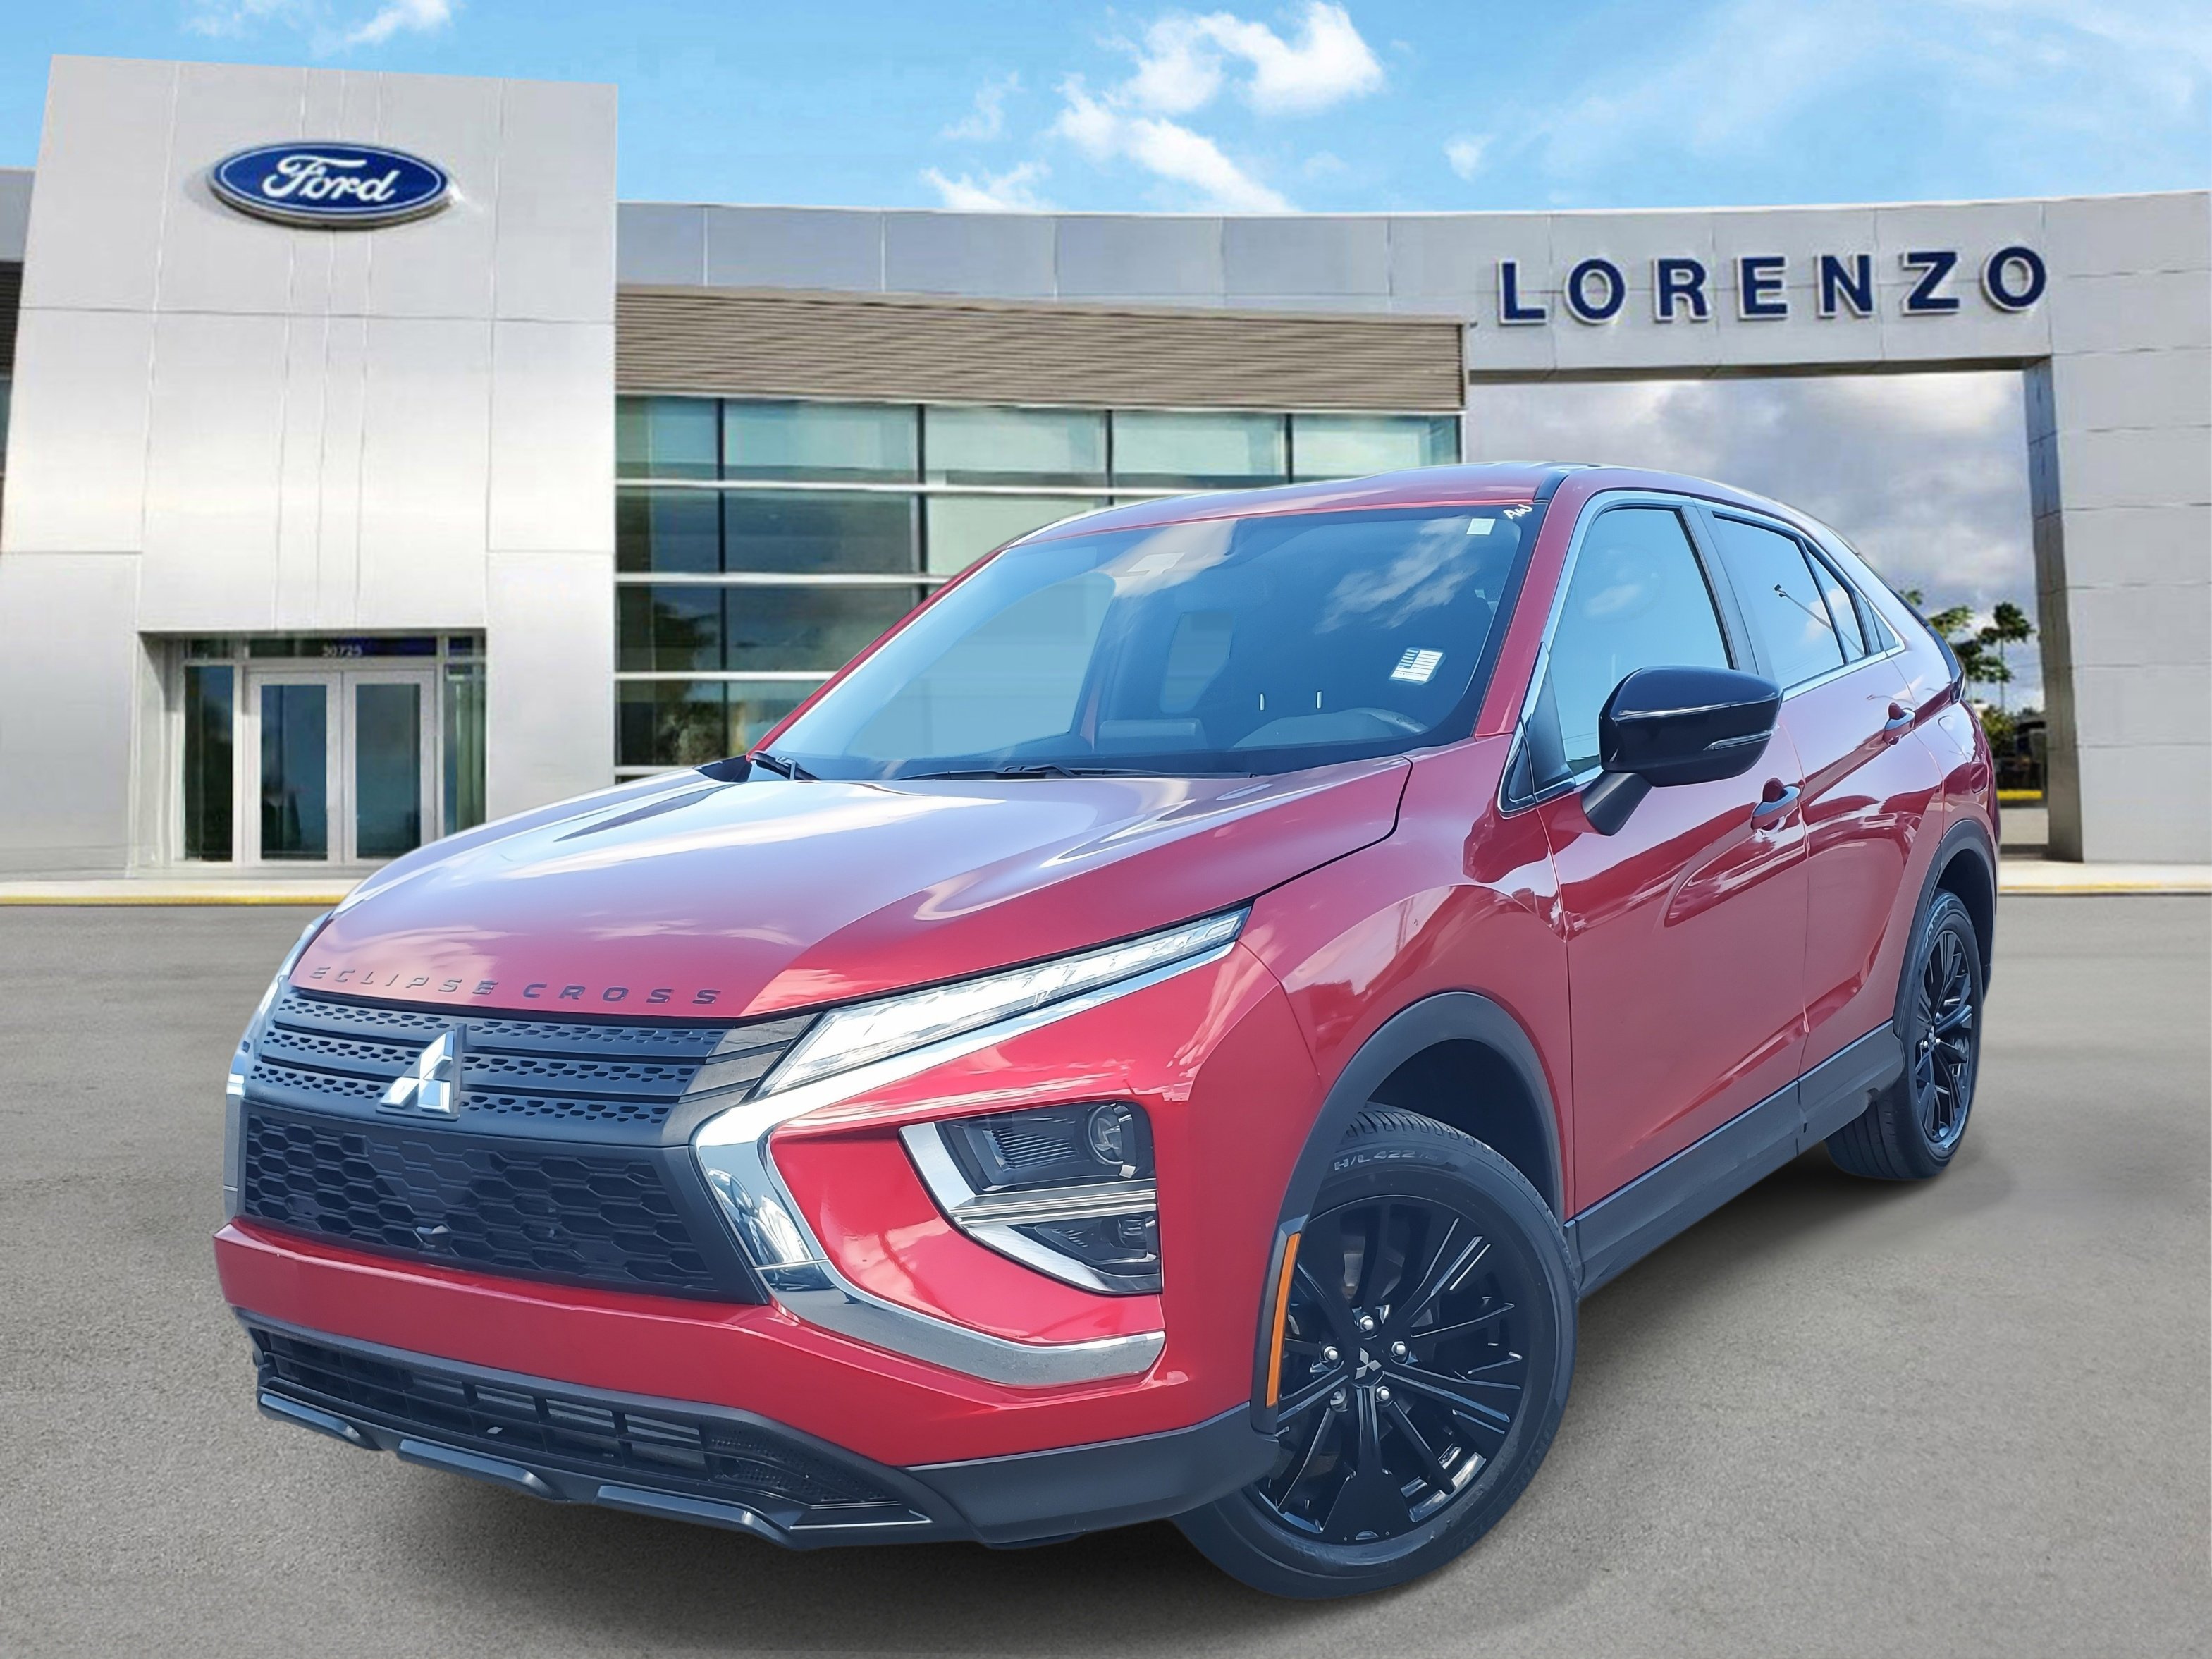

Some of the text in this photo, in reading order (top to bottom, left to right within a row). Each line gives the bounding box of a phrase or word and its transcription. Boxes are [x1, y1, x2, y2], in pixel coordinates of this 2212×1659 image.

[262, 154, 400, 202] Ford
[1498, 246, 2047, 325] LORENZO
[309, 967, 722, 1005] ECLIPSE CROSS
